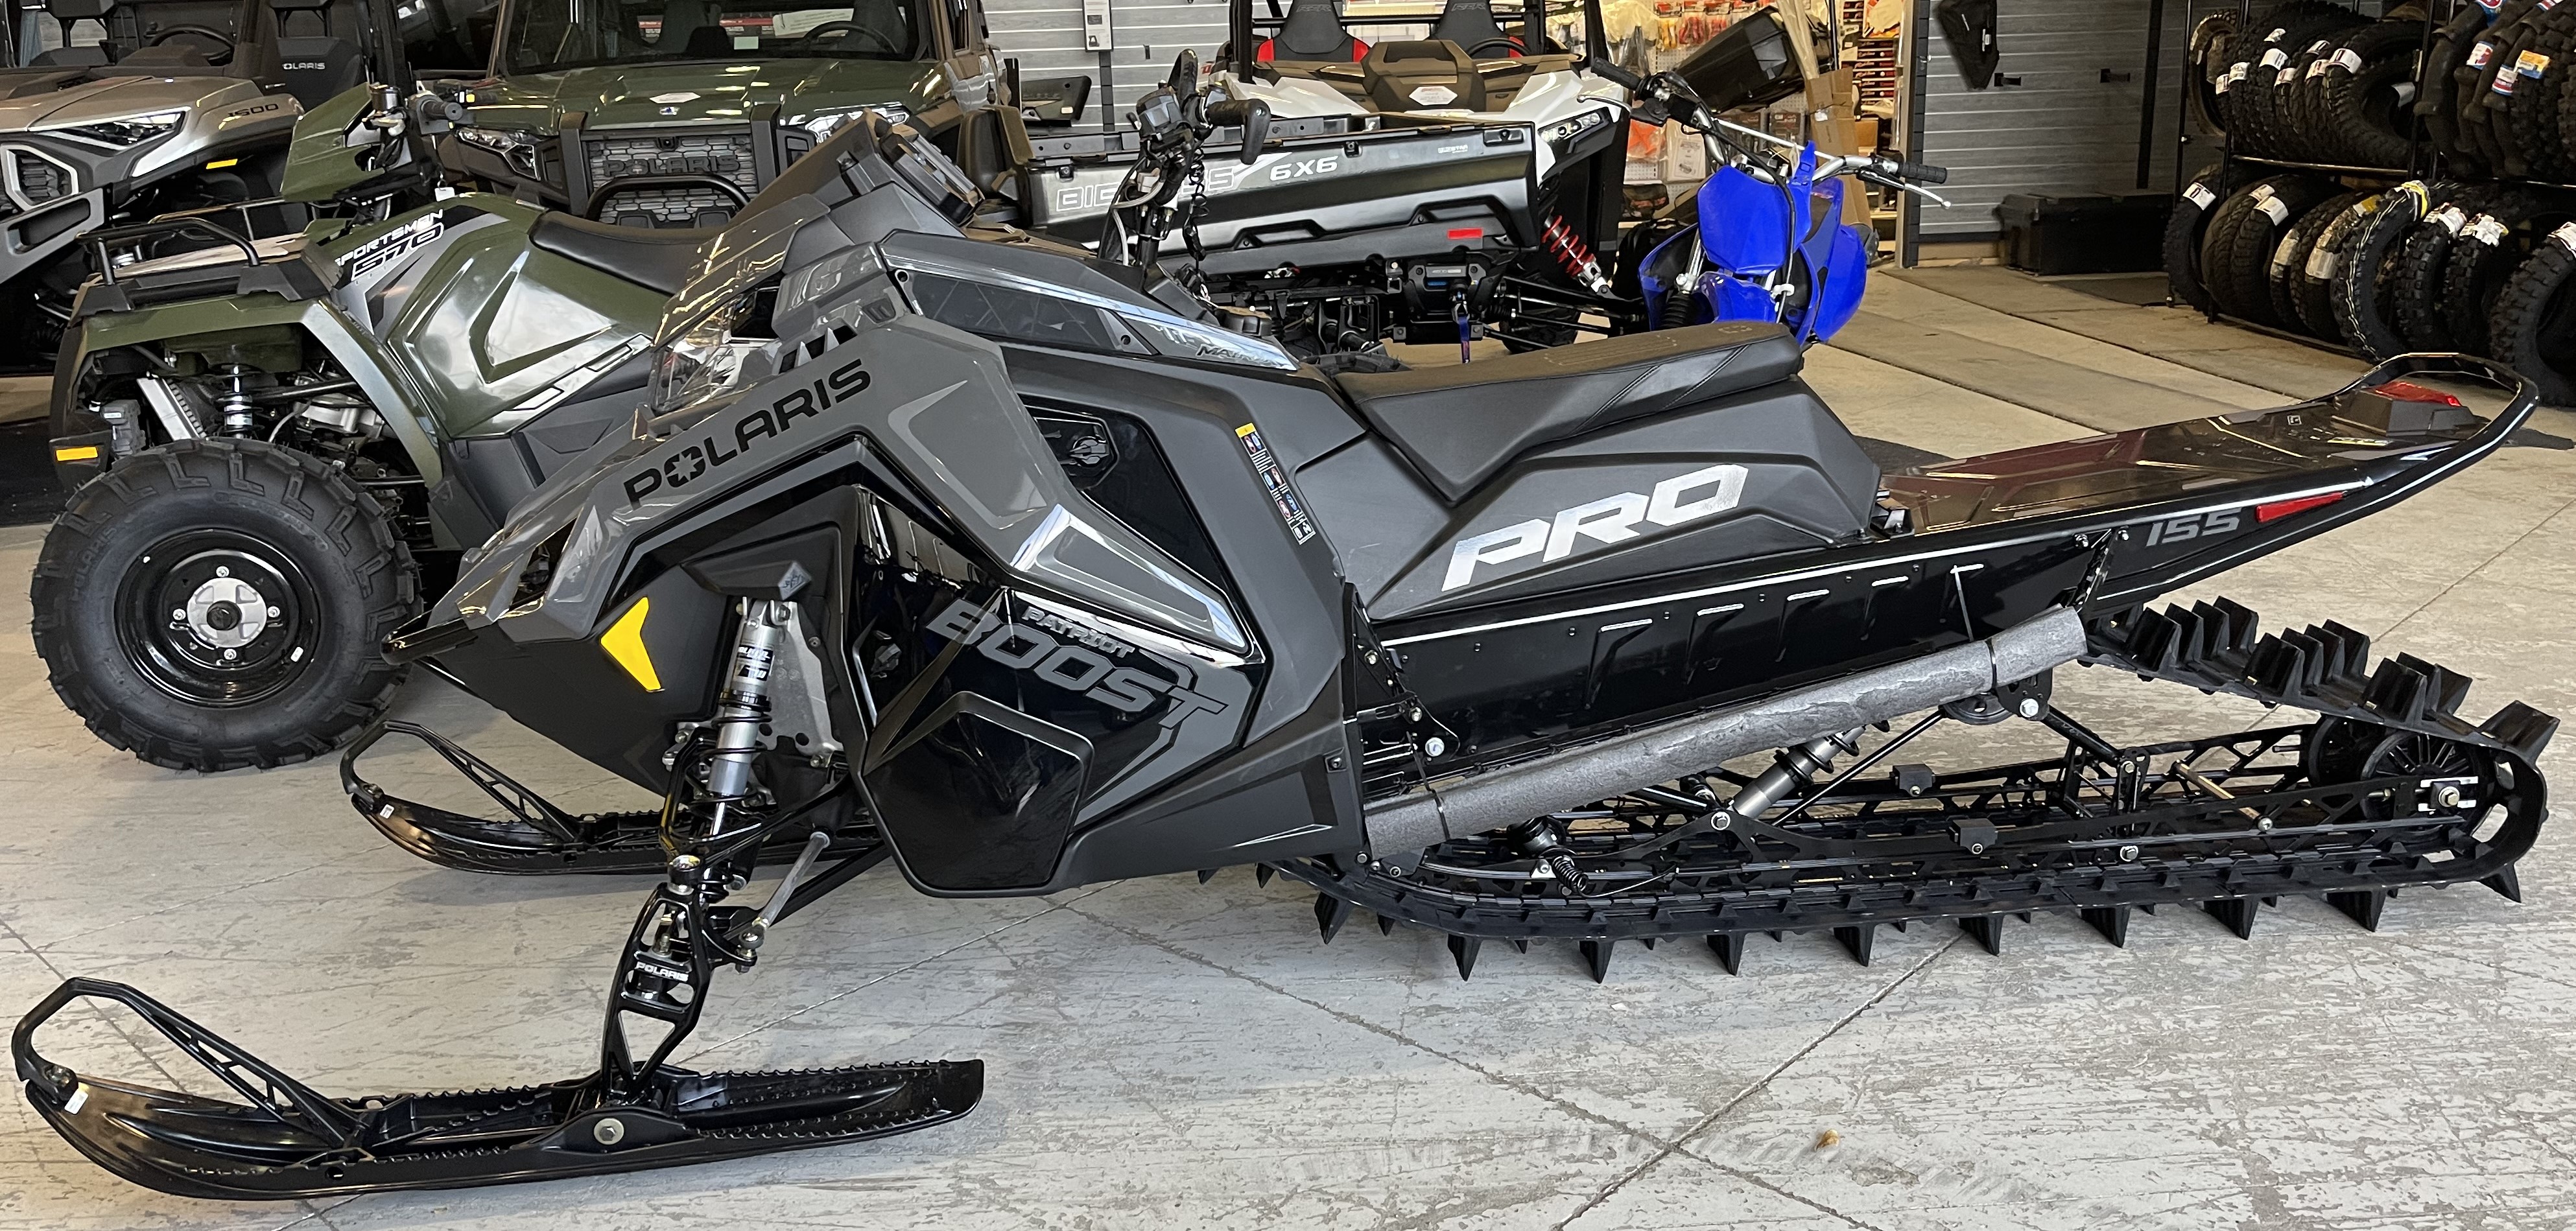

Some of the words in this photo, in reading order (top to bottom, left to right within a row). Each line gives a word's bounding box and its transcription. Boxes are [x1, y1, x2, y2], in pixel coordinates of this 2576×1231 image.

[603, 154, 741, 177] POLARIS
[1270, 156, 1338, 182] 6X6
[351, 222, 445, 282] 570
[624, 358, 871, 510] POLARIS
[1441, 463, 1749, 591] PRO
[2145, 506, 2243, 547] 155
[1021, 605, 1135, 659] PATRIOT
[926, 598, 1229, 731] BOOST
[635, 961, 689, 981] POLARIS
